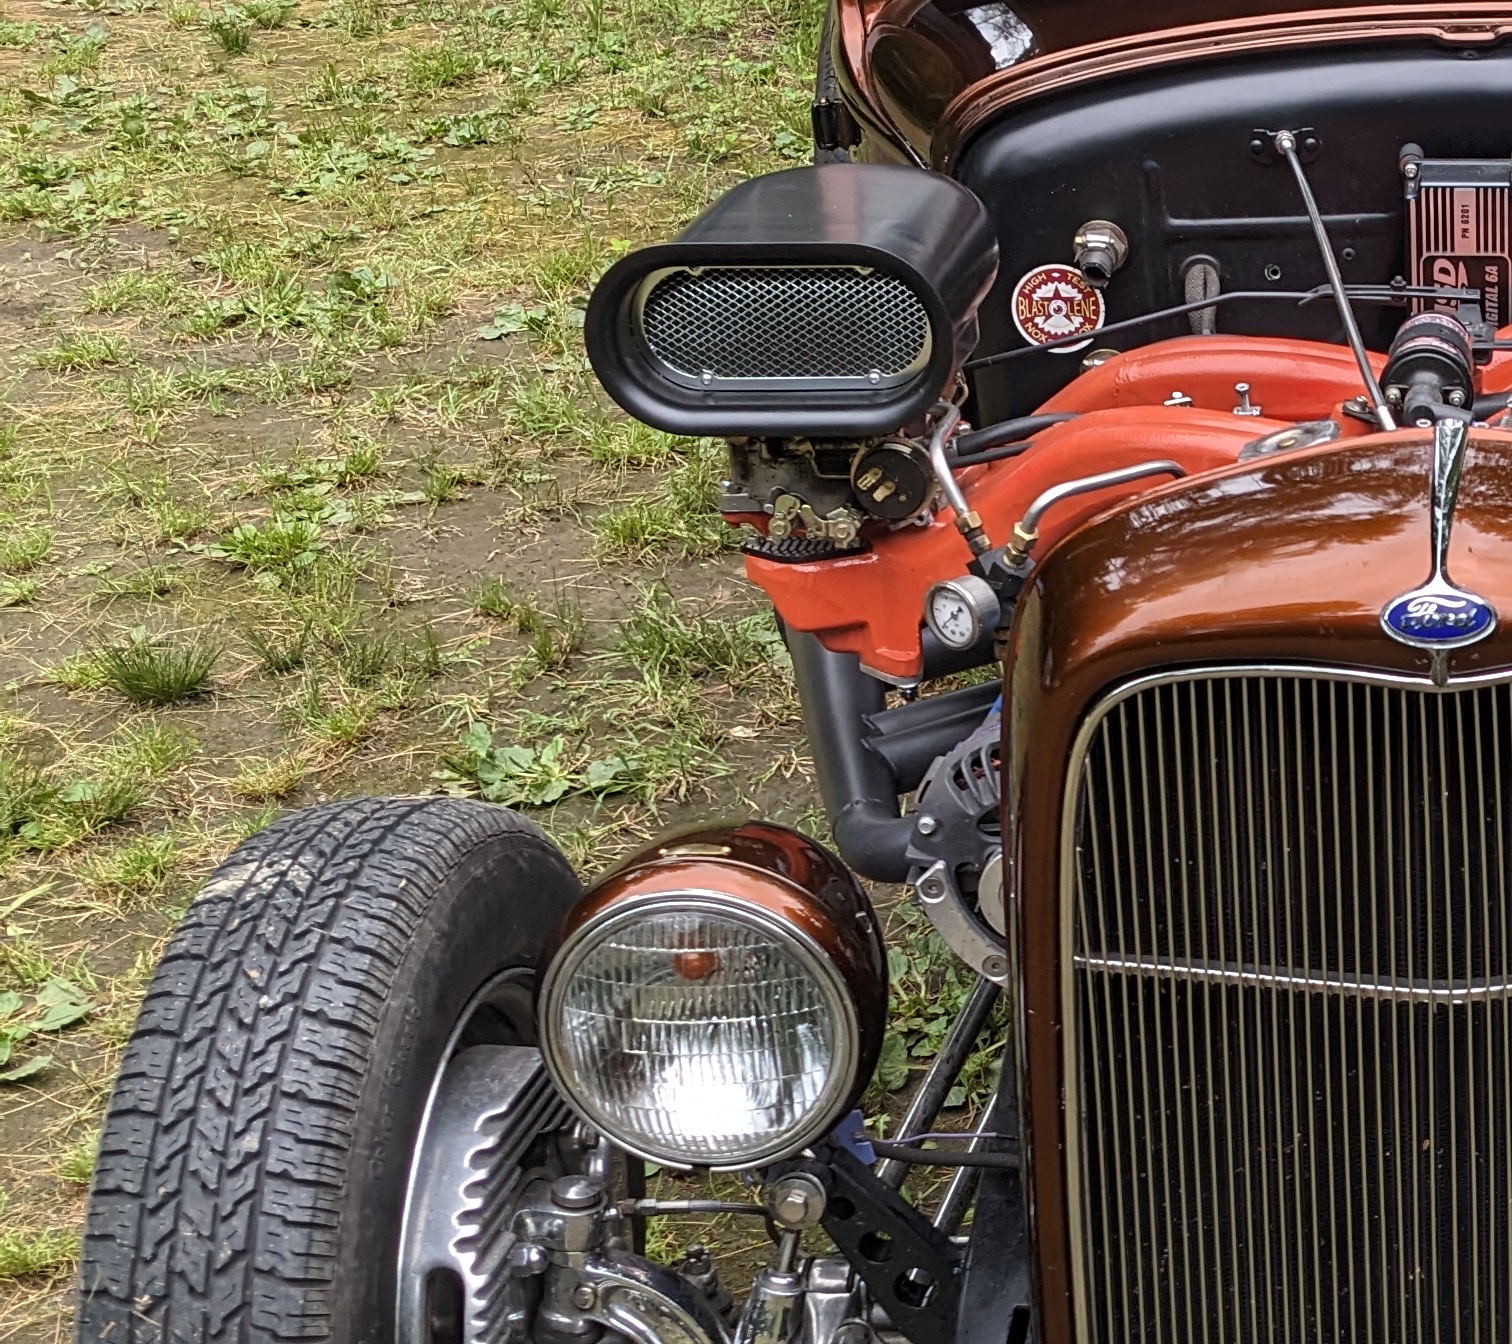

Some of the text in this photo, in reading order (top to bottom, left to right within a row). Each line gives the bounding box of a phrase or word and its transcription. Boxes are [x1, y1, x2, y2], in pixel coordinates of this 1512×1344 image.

[1461, 204, 1469, 239] PN 6201
[1022, 272, 1092, 294] HIGH TEST
[1485, 265, 1499, 283] 6A
[1018, 296, 1050, 320] BLAST
[1399, 596, 1478, 630] Ford
